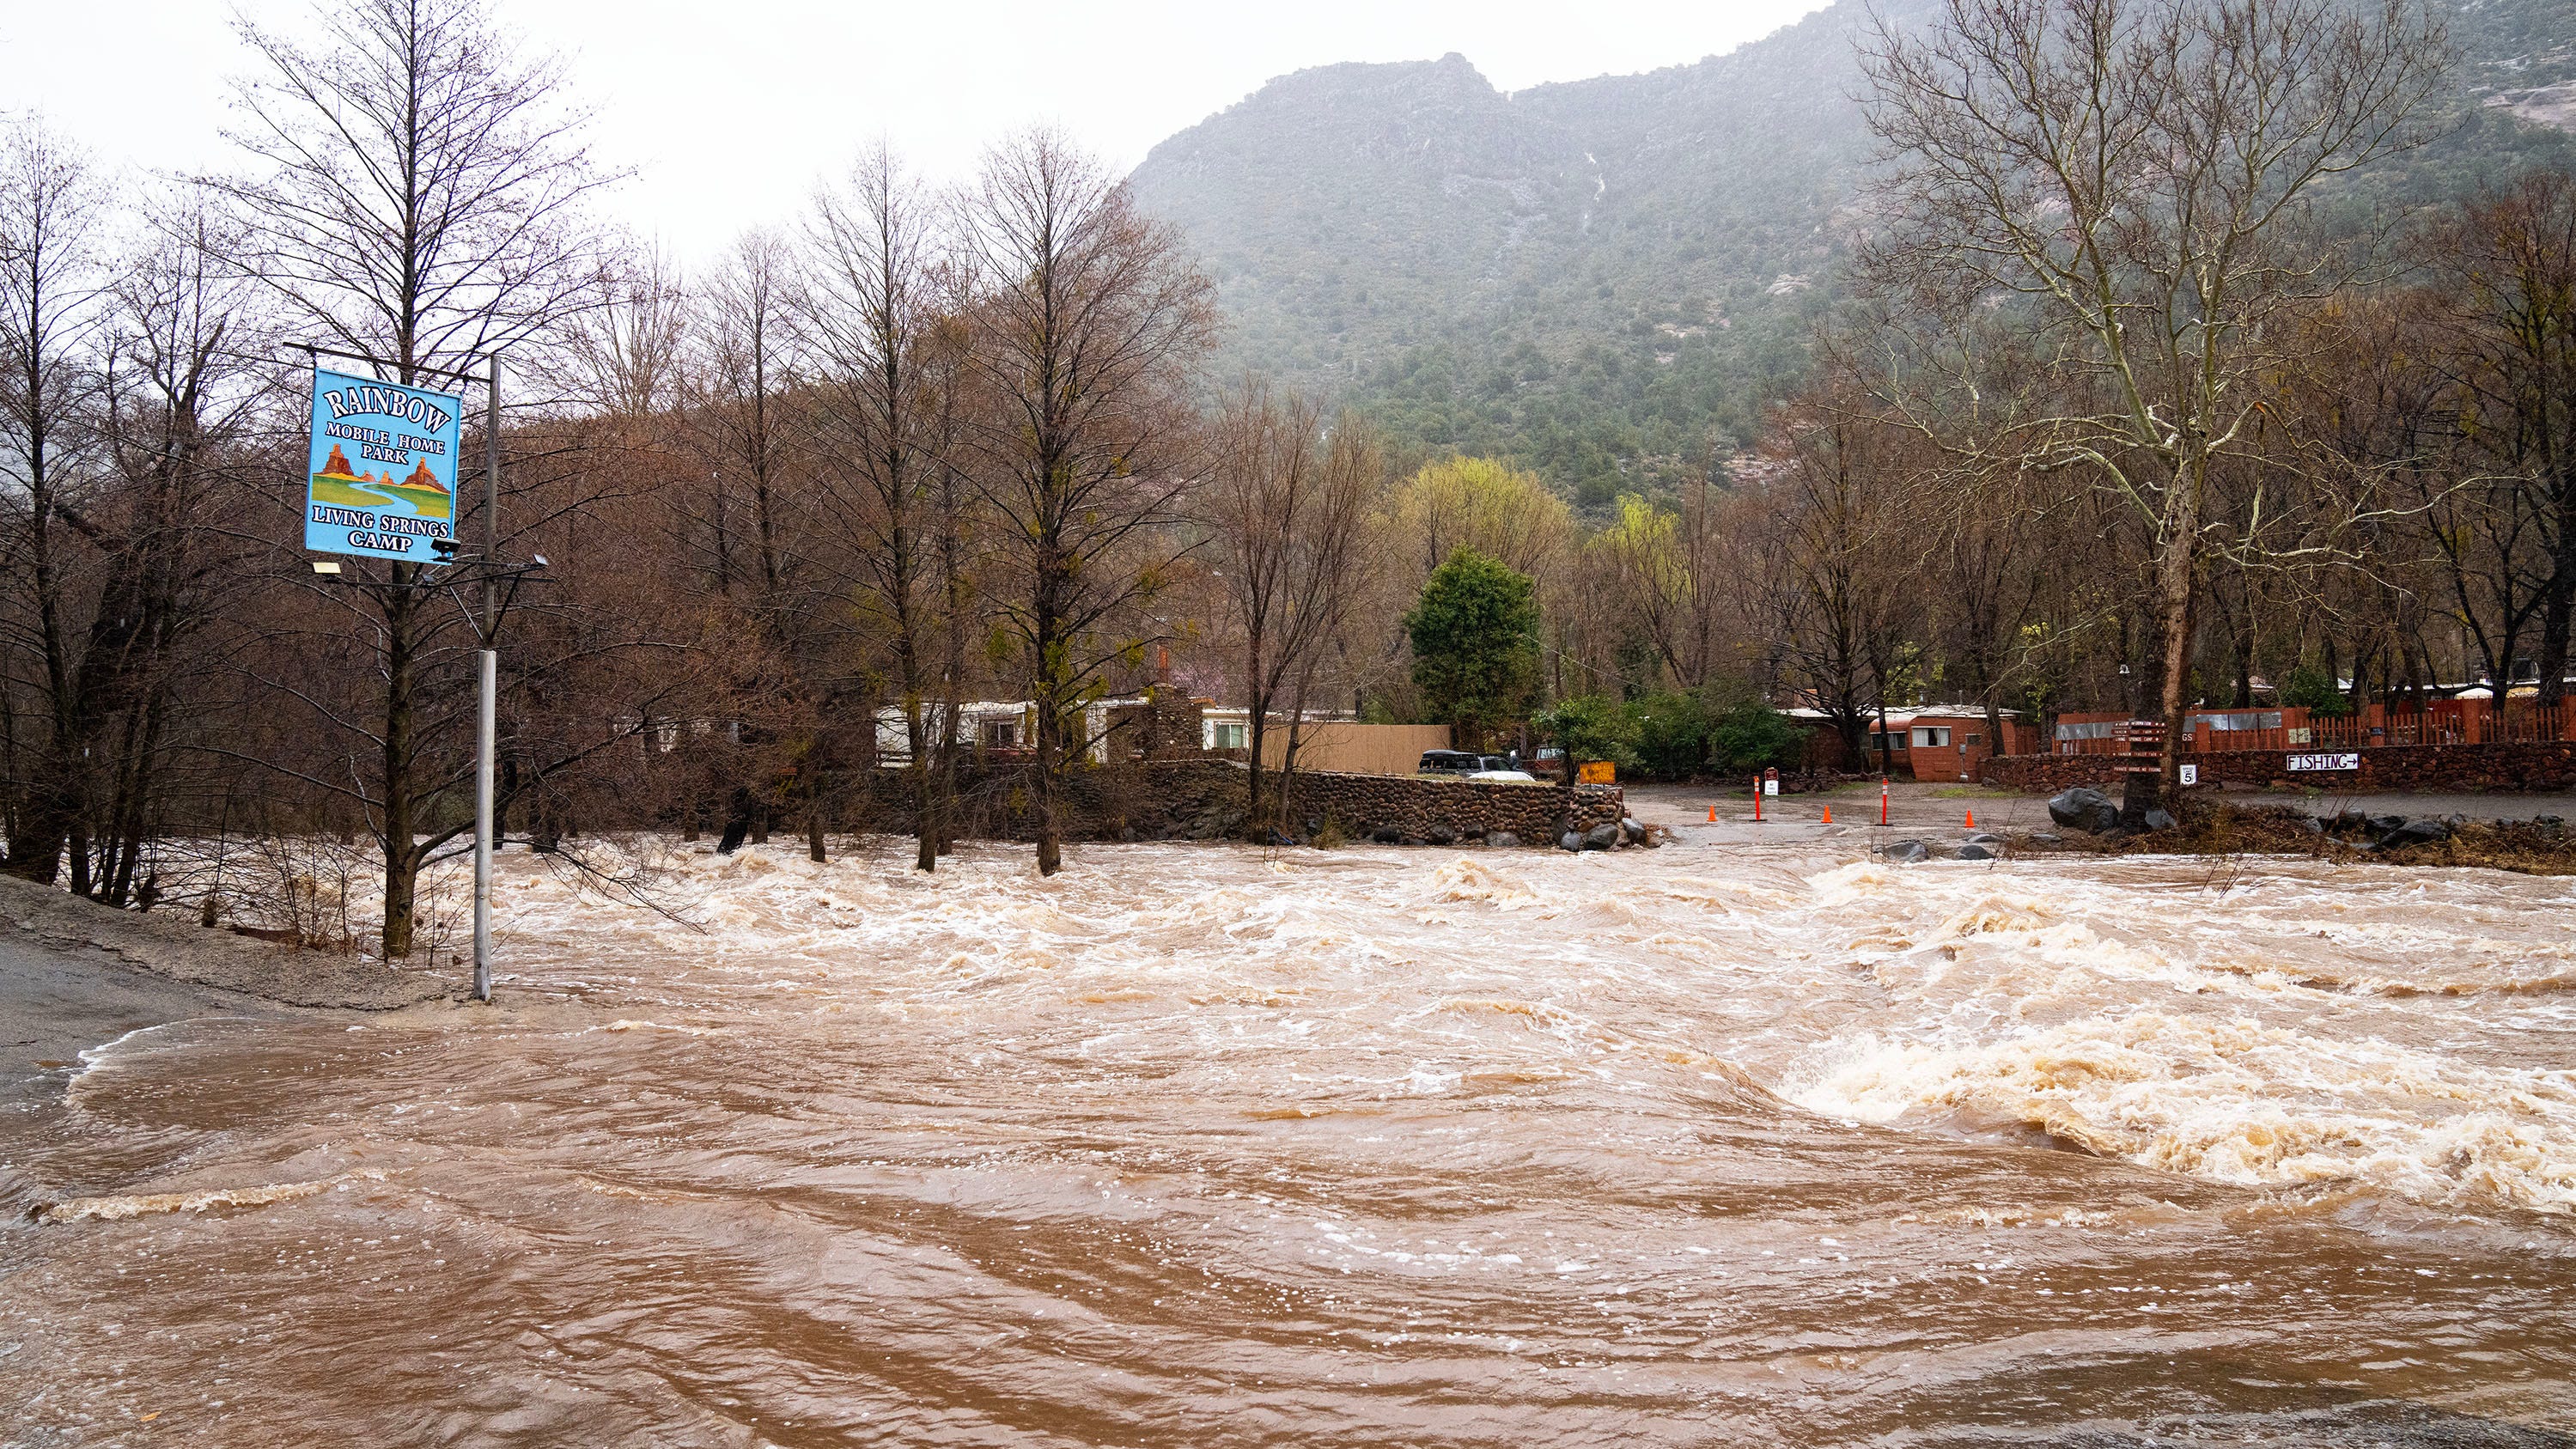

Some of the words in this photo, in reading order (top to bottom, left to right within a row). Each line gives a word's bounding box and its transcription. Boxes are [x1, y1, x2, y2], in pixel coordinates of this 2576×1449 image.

[323, 386, 452, 435] RAINBOW
[326, 421, 390, 446] MOBILE
[397, 433, 446, 455] HOME
[361, 443, 409, 466] PARK
[312, 505, 375, 529] LIVING
[381, 514, 450, 539] SPRINGS
[348, 531, 413, 553] CAMP
[2287, 755, 2348, 770] FISHING
[2184, 773, 2192, 782] 5
